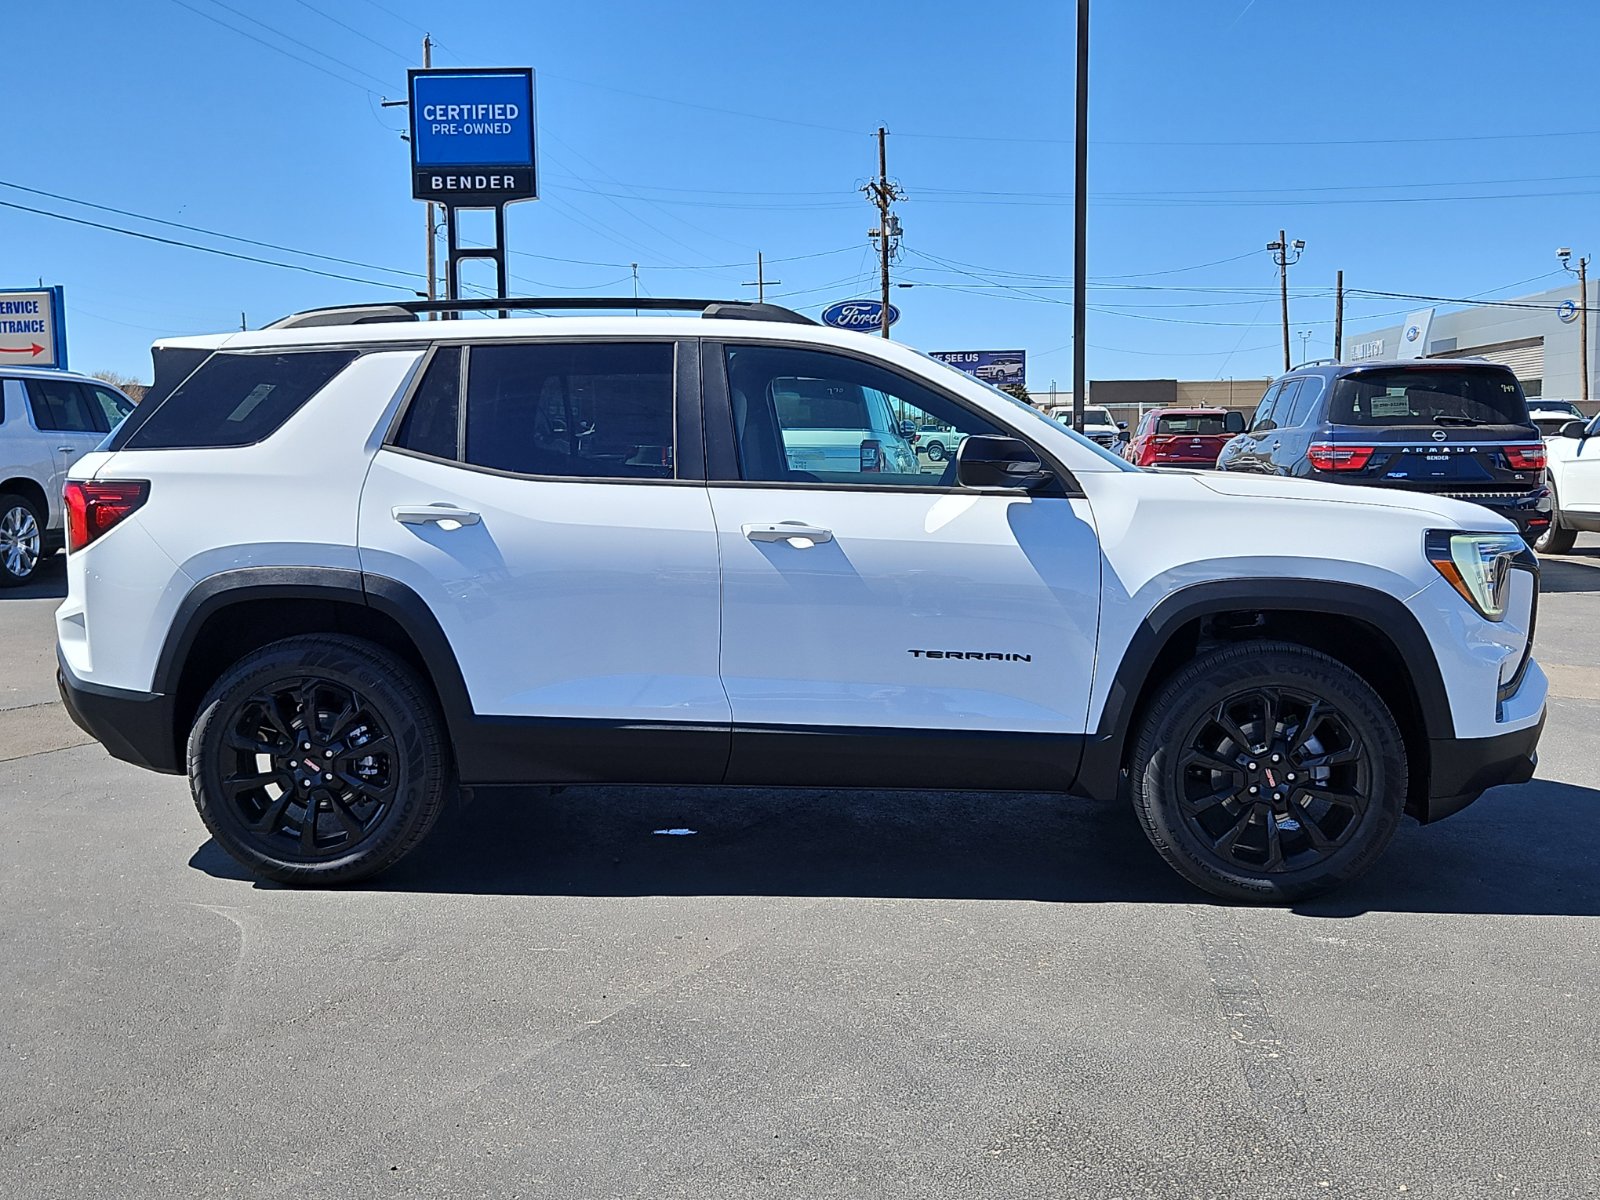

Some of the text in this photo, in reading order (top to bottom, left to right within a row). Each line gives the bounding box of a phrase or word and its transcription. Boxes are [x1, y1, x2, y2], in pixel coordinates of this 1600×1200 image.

[423, 104, 519, 120] CERTIFIED
[432, 123, 512, 135] PRE-OWNED
[431, 175, 515, 190] BENDER
[0, 301, 39, 314] ERVICE
[838, 305, 882, 325] Ford
[944, 353, 964, 363] SEE
[965, 353, 979, 362] US
[907, 649, 1032, 663] TERRAIN
